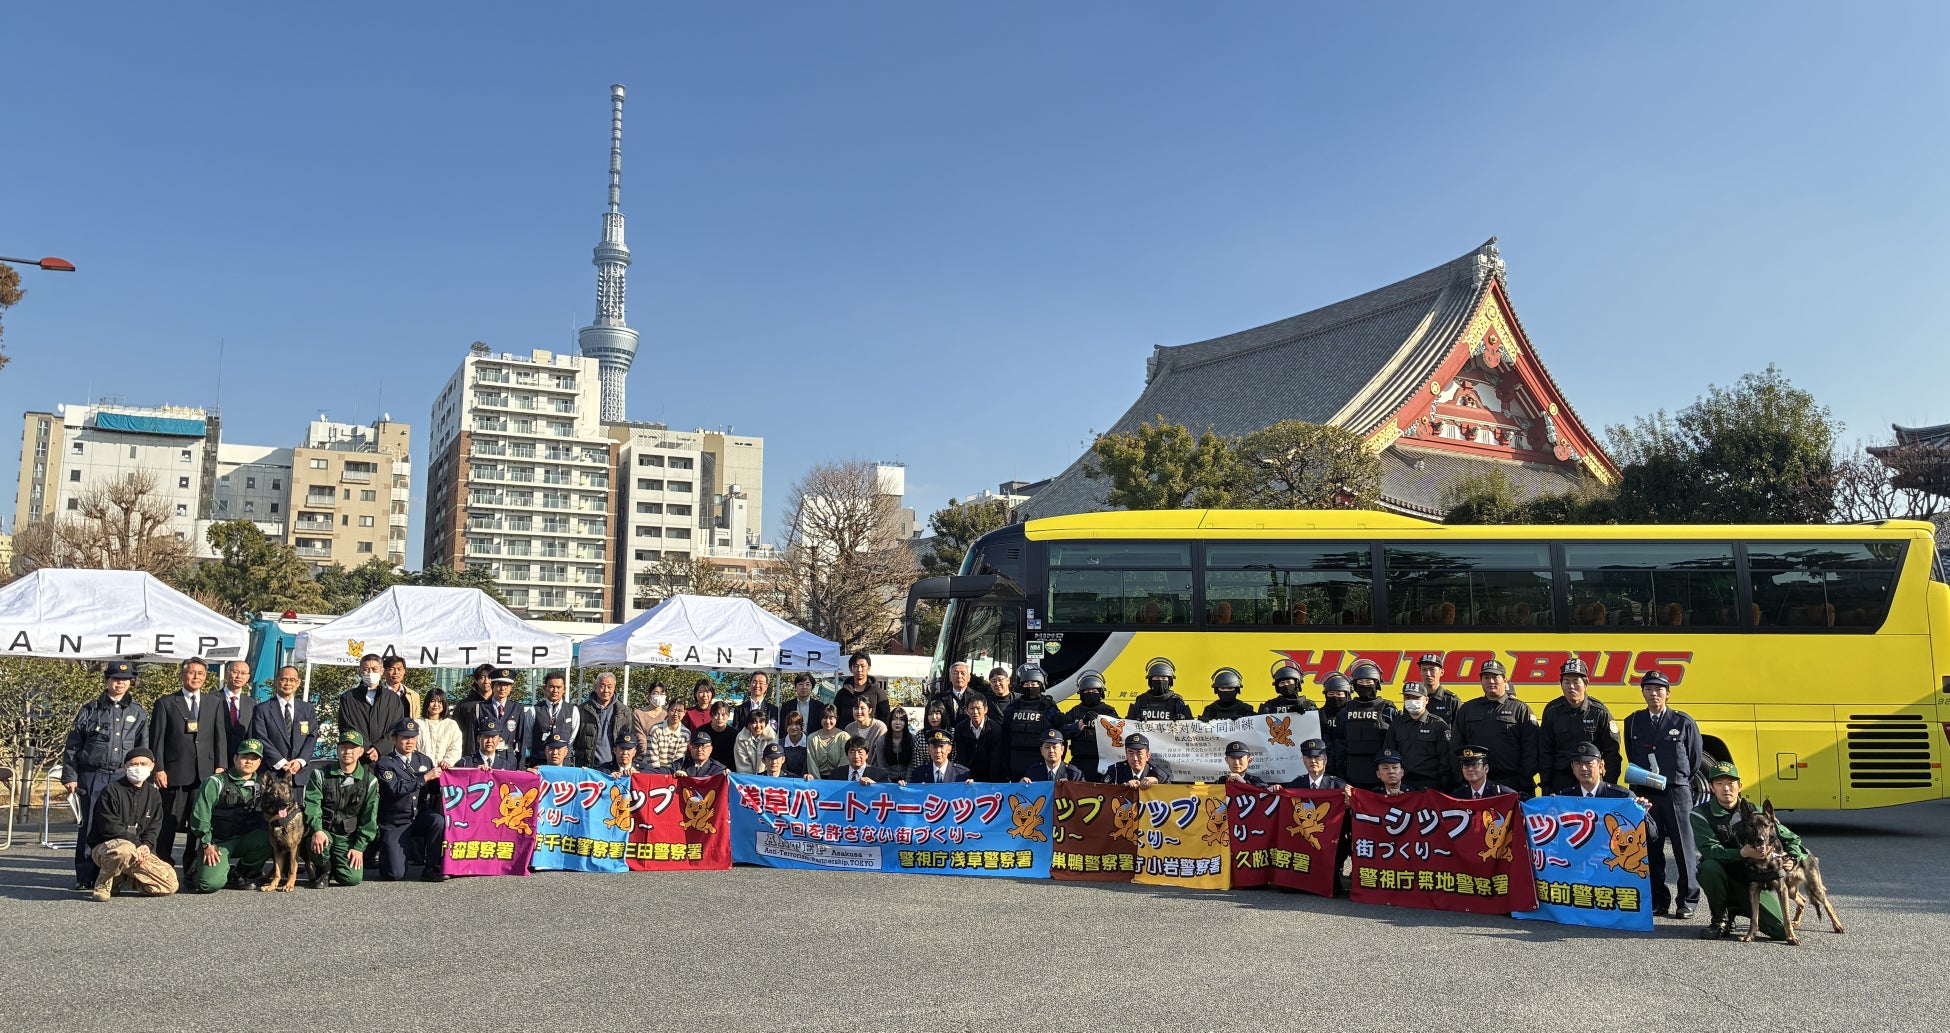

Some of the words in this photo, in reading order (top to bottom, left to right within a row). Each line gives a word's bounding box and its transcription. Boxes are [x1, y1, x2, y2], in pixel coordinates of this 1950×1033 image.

[8, 630, 219, 655] ANTEP
[383, 644, 549, 665] ANTEP
[684, 645, 822, 667] ANTEP
[1270, 650, 1496, 686] HATO
[1505, 650, 1694, 686] BUS
[1012, 712, 1041, 722] POLICE
[1142, 710, 1170, 720] POLICE
[1347, 711, 1379, 720] POLICE
[737, 783, 1003, 825] 浅草パートナーシップ
[1355, 806, 1474, 840] ーシップ
[1526, 808, 1599, 850] ップ
[441, 840, 515, 860] 森警察署
[831, 849, 863, 858] Asakusa
[1052, 851, 1135, 873] 巣鴨警察署
[1536, 879, 1641, 912] 蔵前警察署
